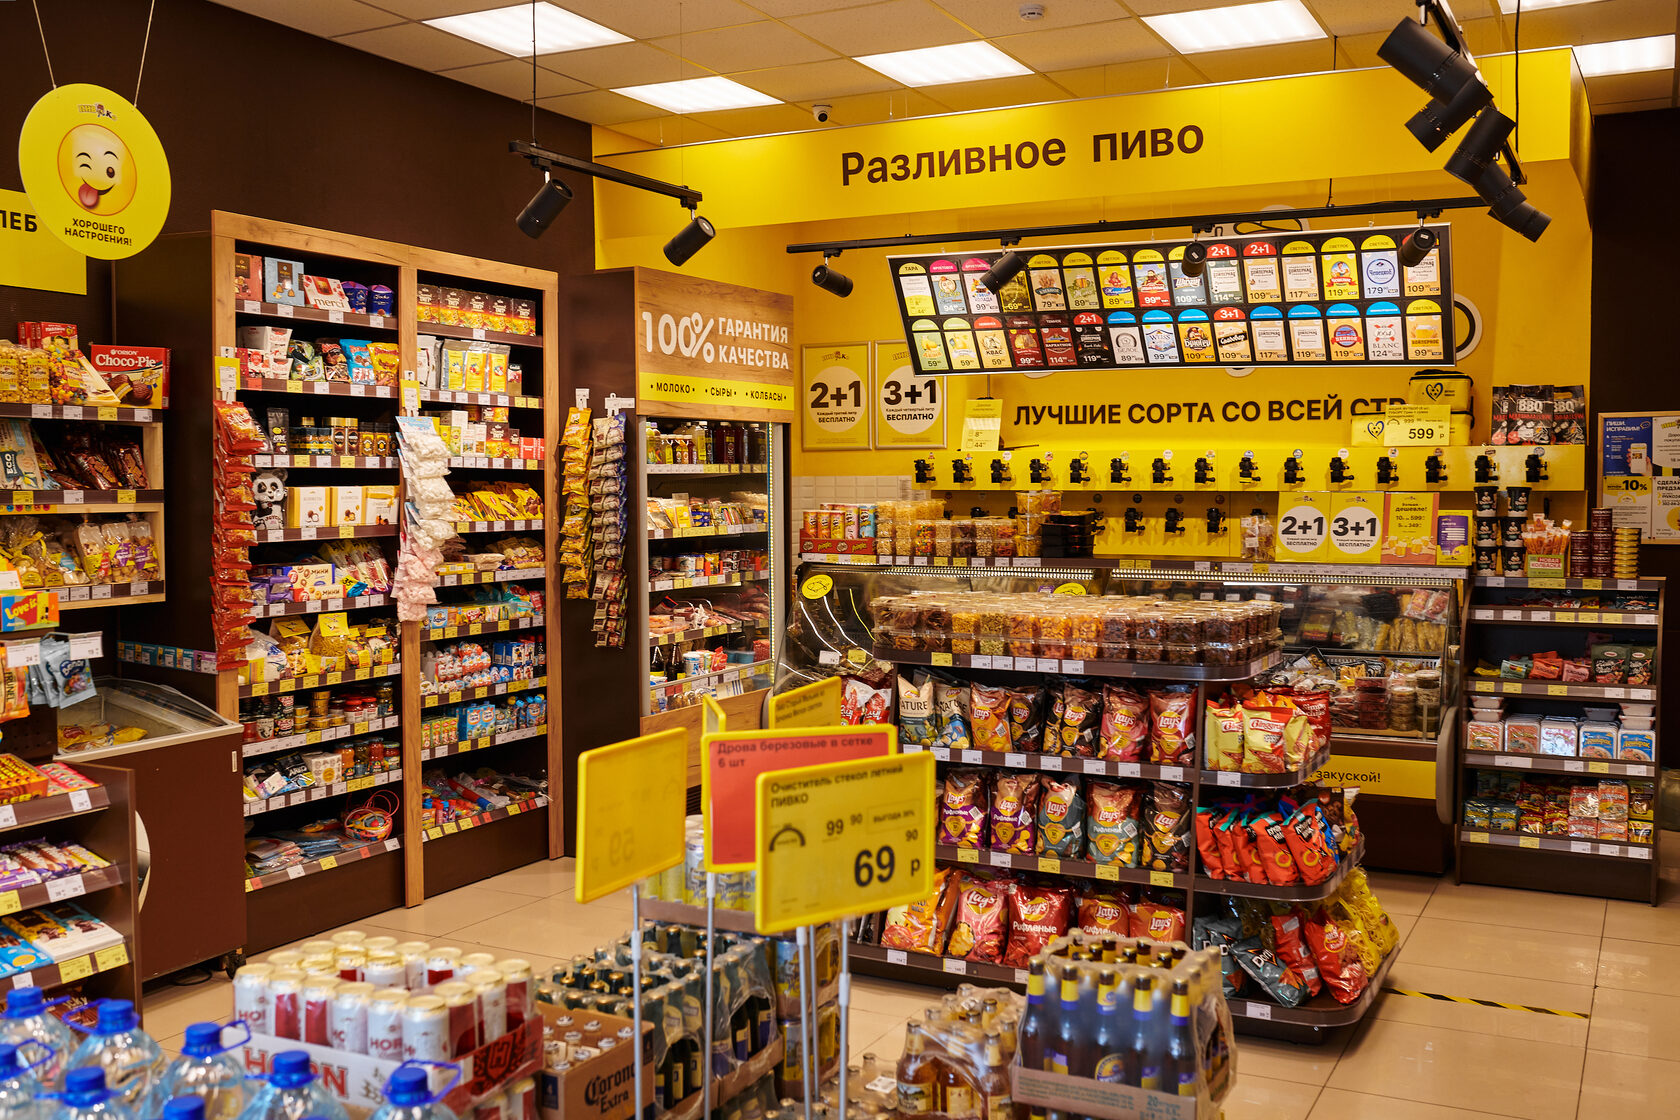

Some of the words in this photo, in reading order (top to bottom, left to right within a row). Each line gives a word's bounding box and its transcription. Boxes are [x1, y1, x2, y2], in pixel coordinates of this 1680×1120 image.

[841, 137, 1066, 186] Разливное
[1092, 124, 1204, 162] пиво
[72, 218, 125, 234] ХОРОШЕГО
[64, 227, 132, 246] НАСТРОЕНИЯ!
[1211, 246, 1230, 256] 2+1
[1250, 244, 1270, 254] 2+1
[314, 297, 345, 309] merci
[1079, 314, 1097, 324] 2+1
[1220, 309, 1239, 319] 3+1
[642, 311, 715, 364] 100%
[718, 317, 788, 344] ГАРАНТИЯ
[718, 344, 789, 370] КАЧЕСТВА
[656, 382, 691, 394] МОЛОКО
[710, 387, 732, 397] СЫРЫ
[750, 390, 783, 401] КОЛБАСЫ
[810, 380, 861, 409] 2+1
[883, 380, 937, 406] 3+1
[1014, 404, 1122, 426] ЛУЧШИЕ
[1130, 401, 1215, 424] СОРТА
[1221, 399, 1261, 422] СО
[1268, 393, 1342, 420] ВСЕЙ
[1518, 400, 1543, 414] BBQ
[886, 413, 934, 421] БЕСПЛАТНО
[1408, 428, 1434, 439] 599
[1622, 480, 1648, 491] 10%
[1281, 516, 1324, 536] 2+1
[1332, 517, 1376, 537] 3+1
[4, 604, 29, 619] Love
[900, 700, 929, 710] ATURE
[973, 707, 991, 720] Lay's
[1012, 707, 1030, 720] Lay's
[1065, 709, 1085, 722] Lay's
[1114, 713, 1134, 727] Lay's
[1159, 716, 1181, 729] Lay's
[717, 742, 757, 756] Дрова
[762, 738, 827, 751] березовые
[831, 739, 838, 747] в
[840, 736, 874, 747] сетке
[718, 758, 726, 768] 6
[728, 758, 746, 768] шт
[770, 777, 828, 794] Очиститель
[830, 769, 868, 785] стекол
[870, 764, 904, 779] летний
[1316, 769, 1381, 783] закуской!
[770, 793, 809, 808] ПИВКО
[946, 792, 965, 805] Lay's
[999, 799, 1019, 811] Lay's
[1046, 801, 1067, 816] Lay's
[1098, 810, 1120, 823] Lay's
[825, 819, 844, 837] 99
[849, 813, 863, 825] 90
[905, 829, 918, 842] 90
[854, 845, 895, 888] 69
[967, 891, 997, 908] Lay's
[1023, 902, 1048, 915] Lay's
[1096, 905, 1120, 920] Lay's
[1012, 920, 1057, 934] Рифленые
[1150, 917, 1171, 932] Lay's
[600, 1089, 630, 1113] Extra
